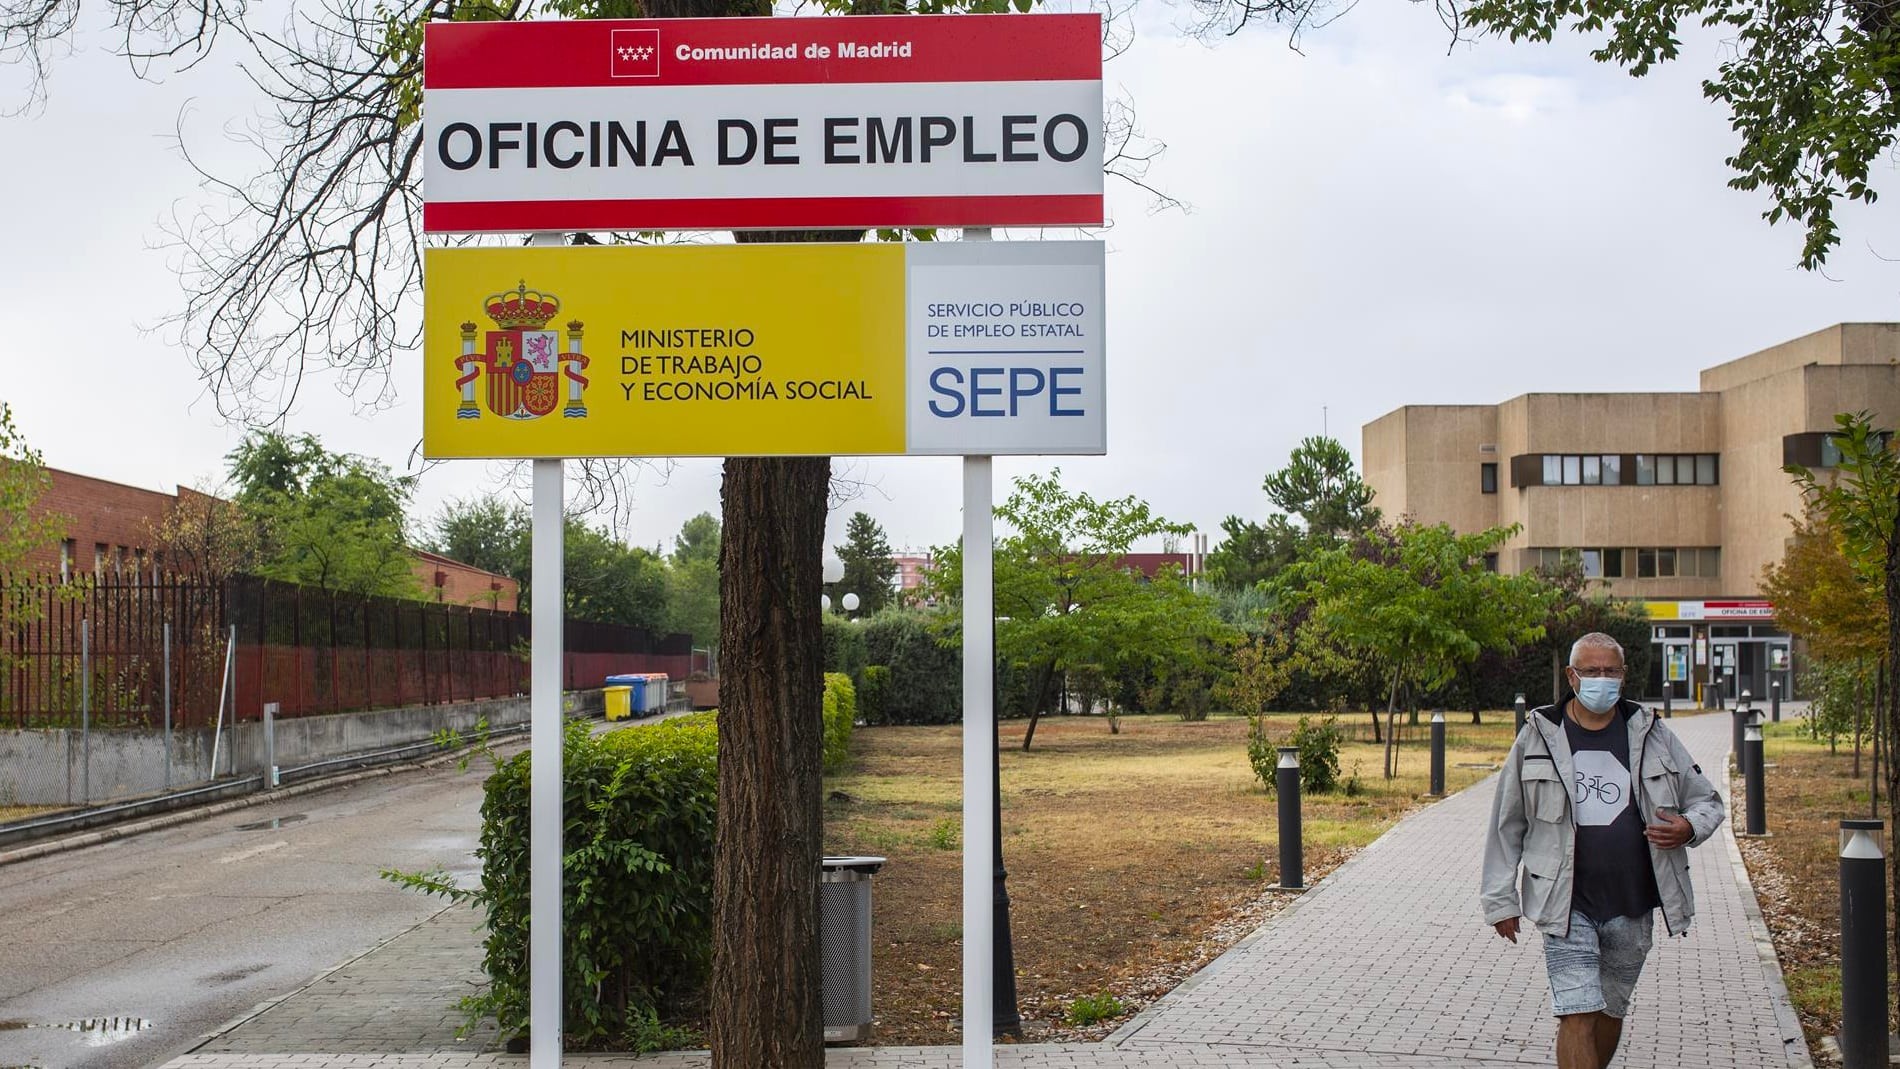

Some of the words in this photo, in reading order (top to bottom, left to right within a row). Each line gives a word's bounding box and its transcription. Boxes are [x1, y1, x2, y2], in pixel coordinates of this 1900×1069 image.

[675, 43, 798, 61] Comunidad
[805, 43, 831, 59] de
[837, 41, 912, 59] Madrid
[437, 119, 695, 171] OFICINA
[717, 118, 800, 166] DE
[824, 113, 1090, 165] EMPLEO
[927, 303, 1004, 318] SERVICIO
[1010, 299, 1085, 319] PÚBLICO
[621, 328, 755, 349] MINISTERIO
[927, 325, 949, 338] DE
[953, 324, 1016, 338] EMPLEO
[1020, 322, 1085, 338] ESTATAL
[621, 356, 652, 375] DE
[656, 354, 762, 379] TRABAJO
[621, 383, 636, 400] Y
[643, 376, 779, 401] ECONOMÍA
[786, 380, 873, 400] SOCIAL
[928, 366, 1086, 419] SEPE
[1721, 608, 1748, 616] OFICINA
[1749, 608, 1757, 616] DE
